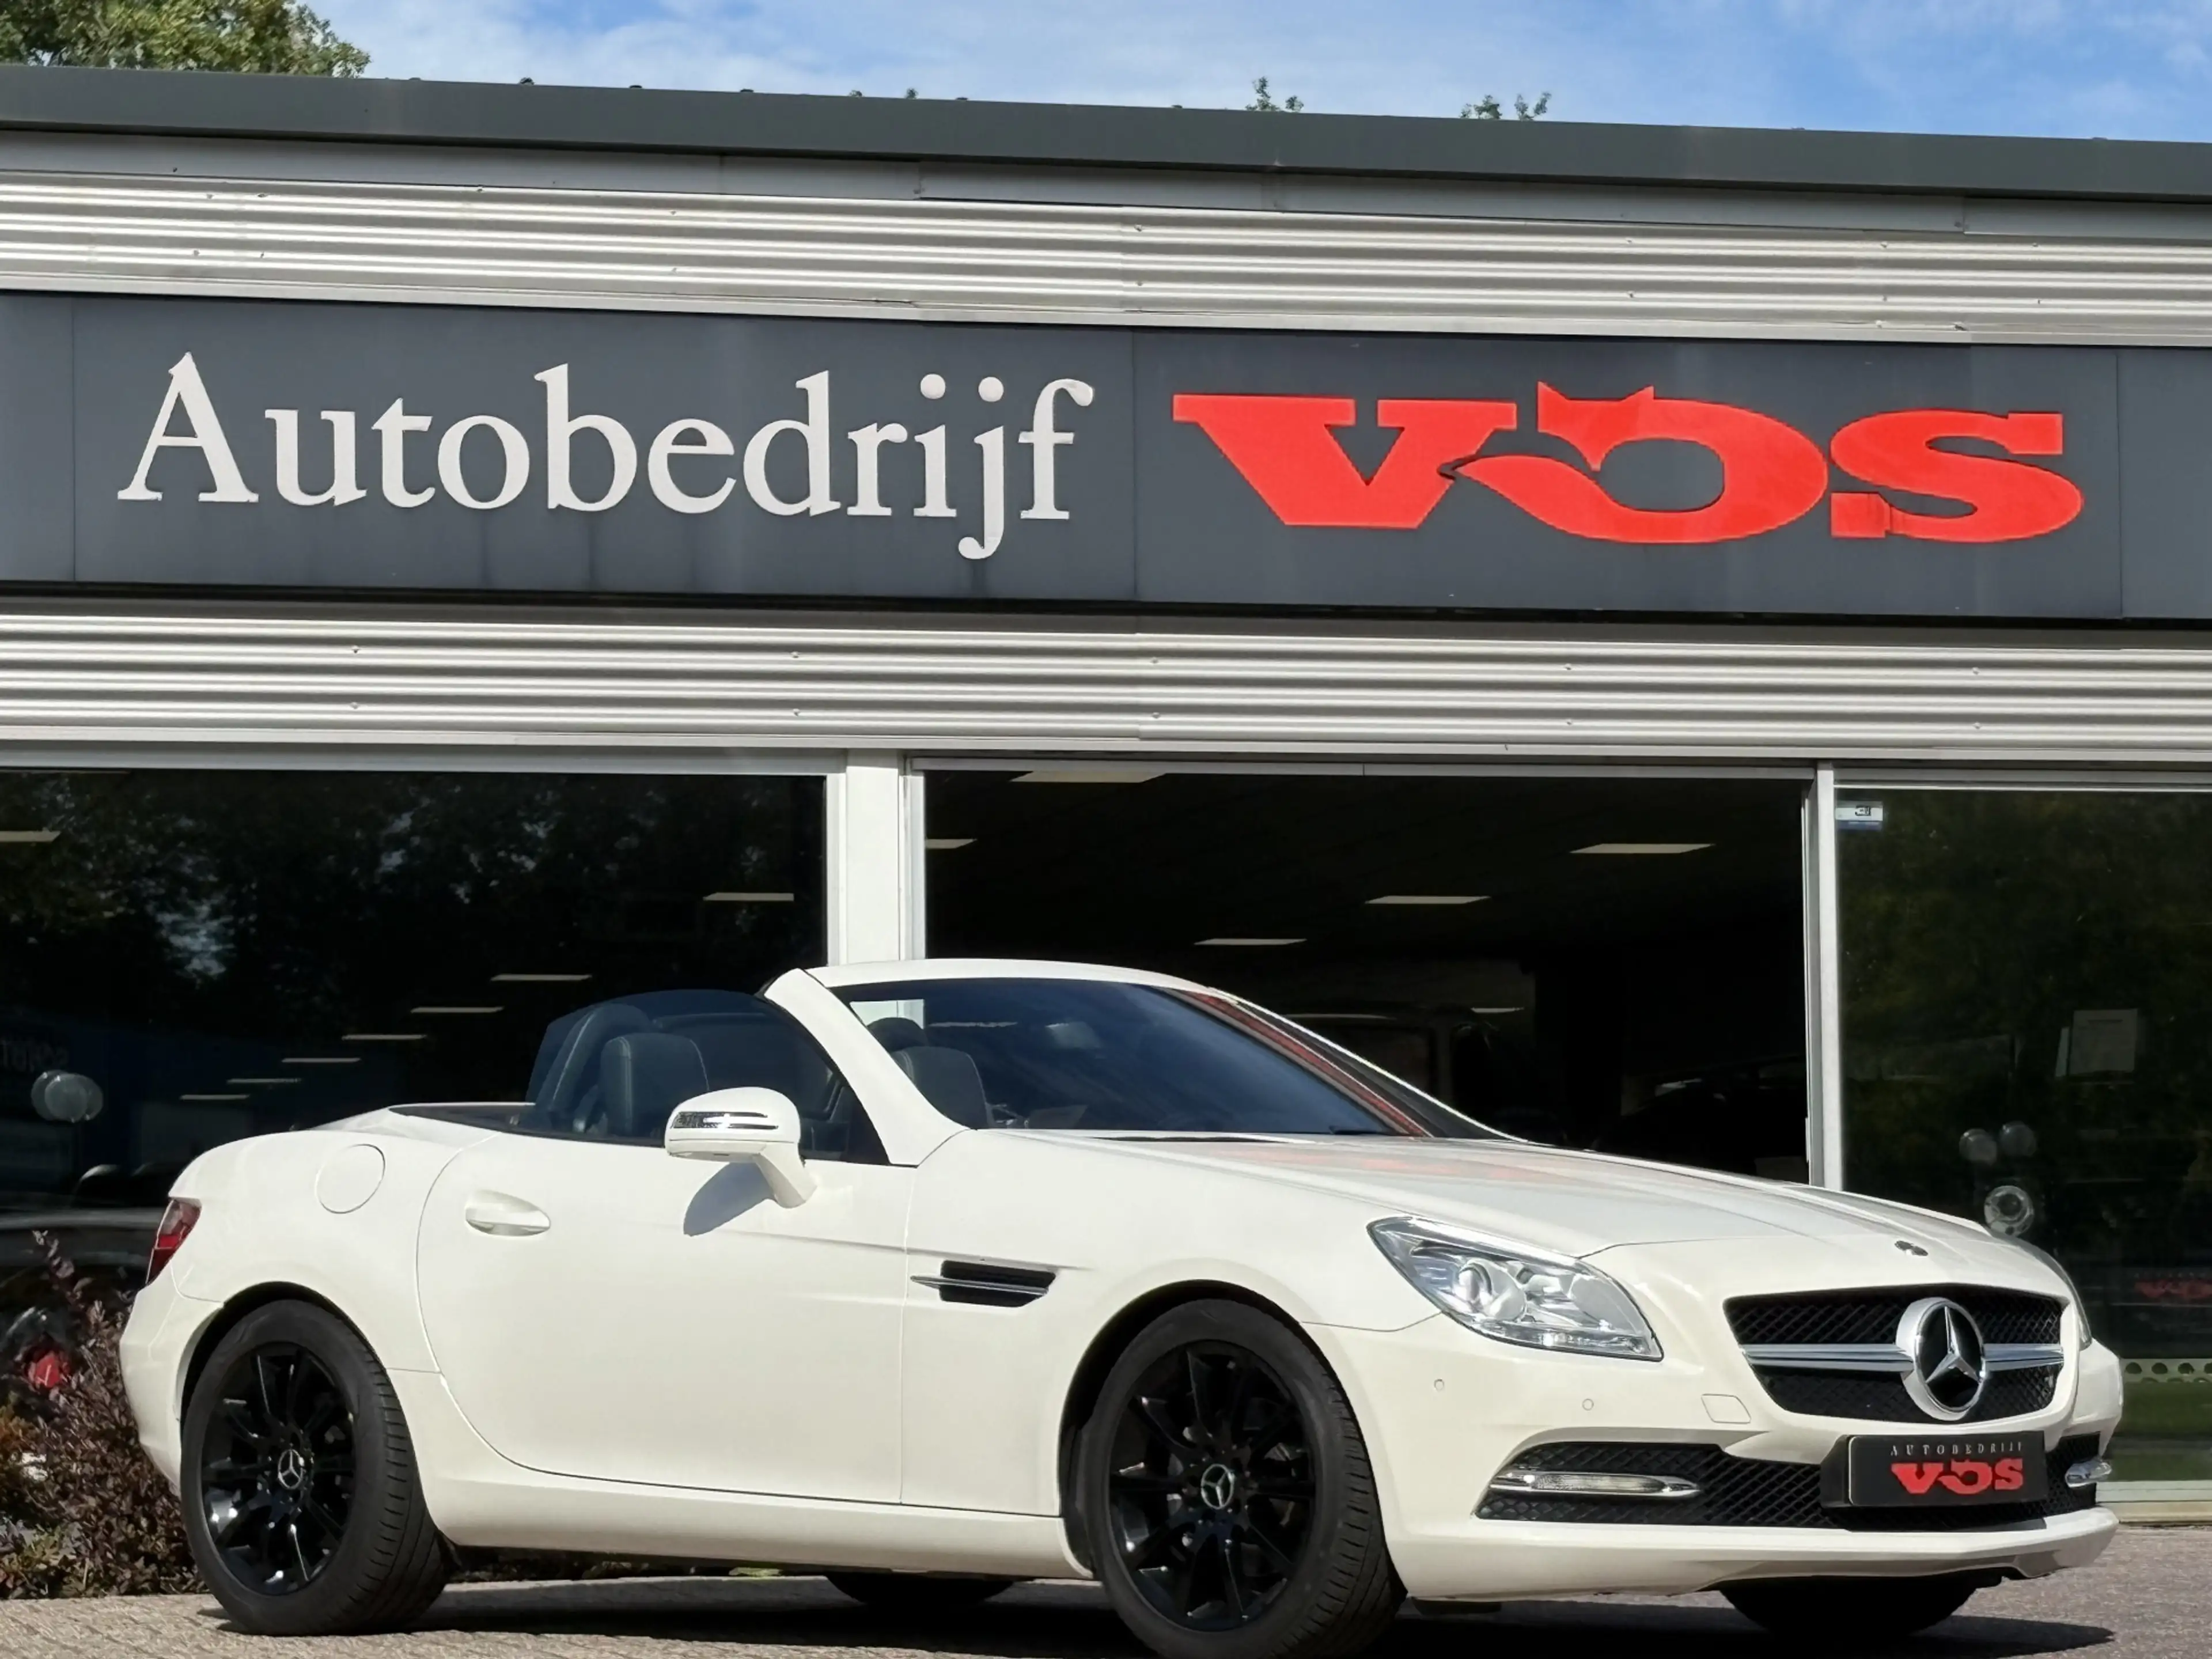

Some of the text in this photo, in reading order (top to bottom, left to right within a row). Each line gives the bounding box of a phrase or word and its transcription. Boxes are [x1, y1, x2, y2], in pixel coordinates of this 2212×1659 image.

[117, 351, 2084, 562] Autobedrijf VOS
[1891, 1458, 2024, 1495] VOS
